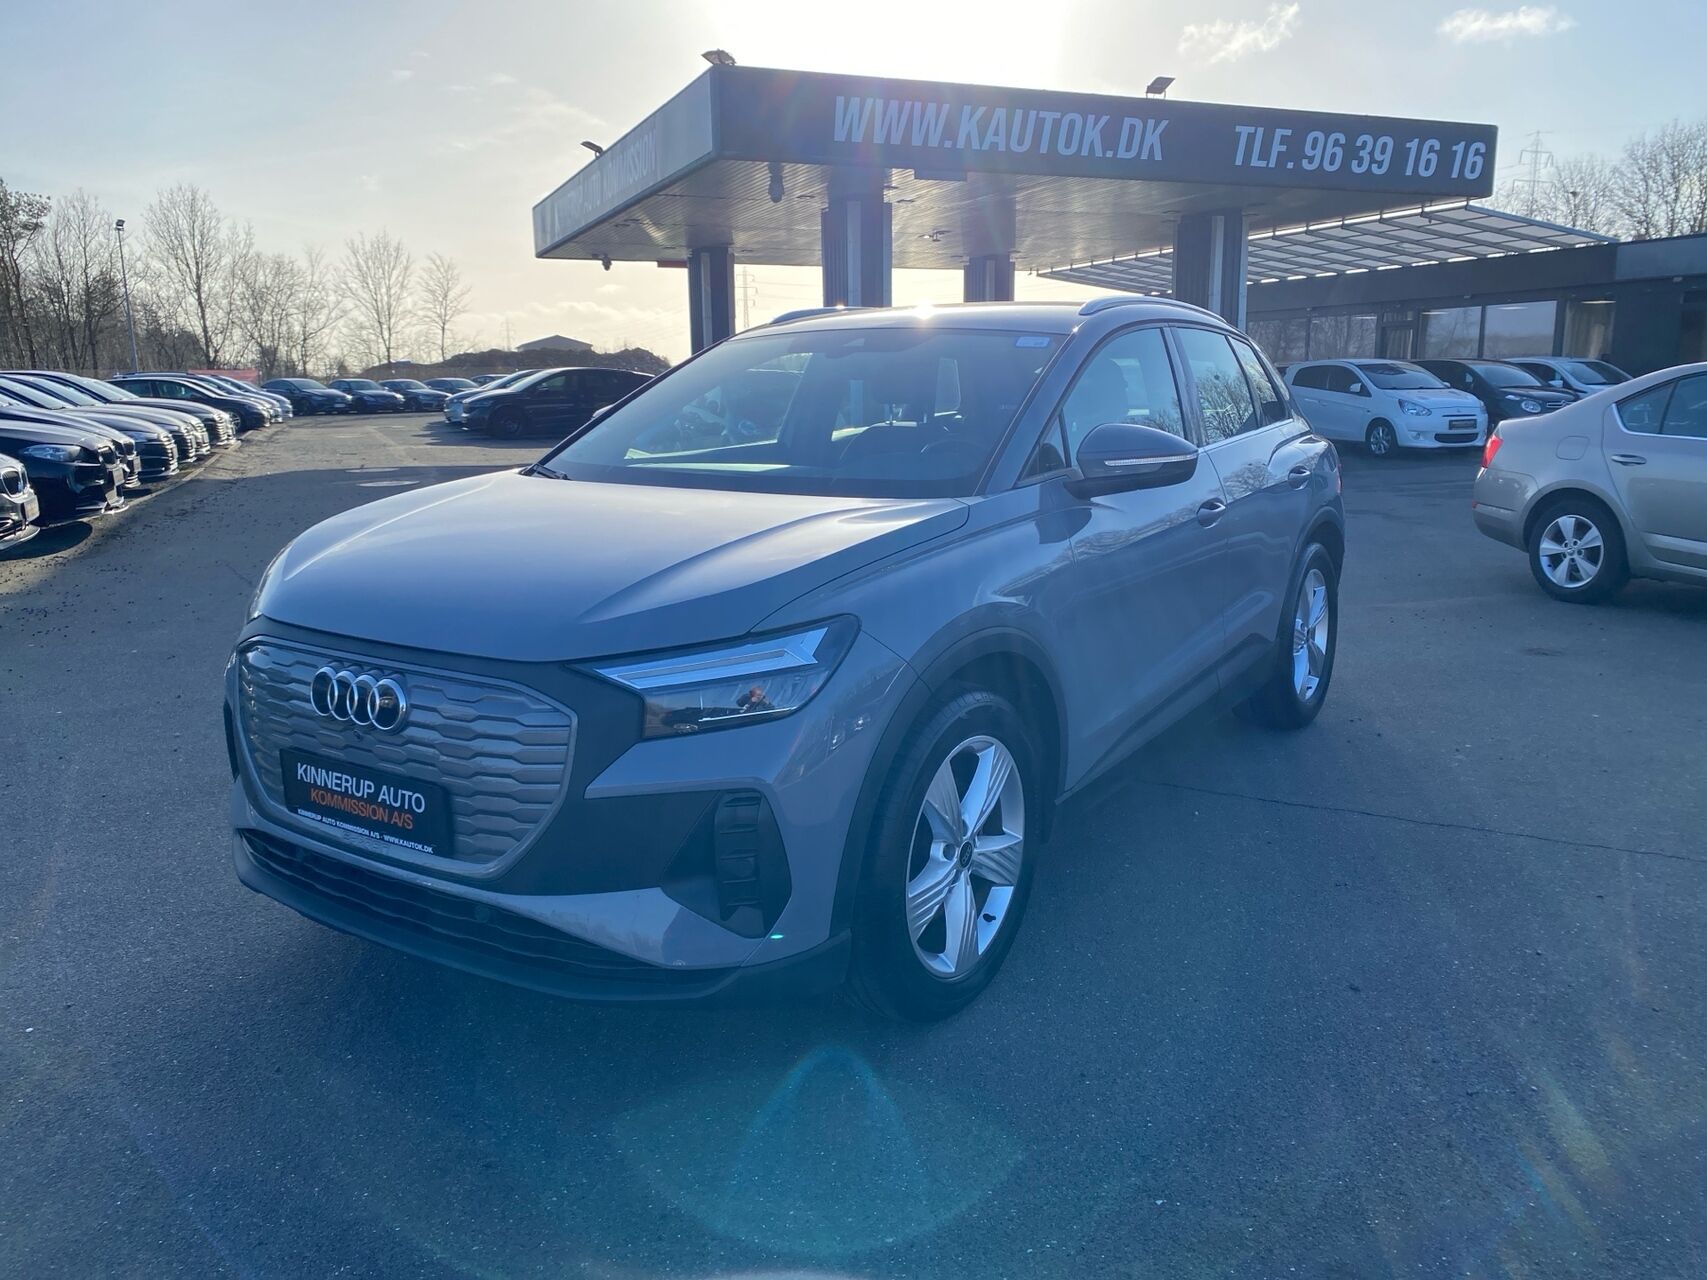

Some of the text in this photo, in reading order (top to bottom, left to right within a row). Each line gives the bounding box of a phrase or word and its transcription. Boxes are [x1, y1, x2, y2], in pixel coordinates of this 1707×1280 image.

[833, 95, 1169, 161] WWW.KAUTOK.DK
[1233, 125, 1487, 180] TLF. 96 39 16 16
[297, 762, 425, 813] KINNERUP AUTO
[310, 788, 414, 830] KOMMISSION A/S
[322, 817, 336, 826] AUTO
